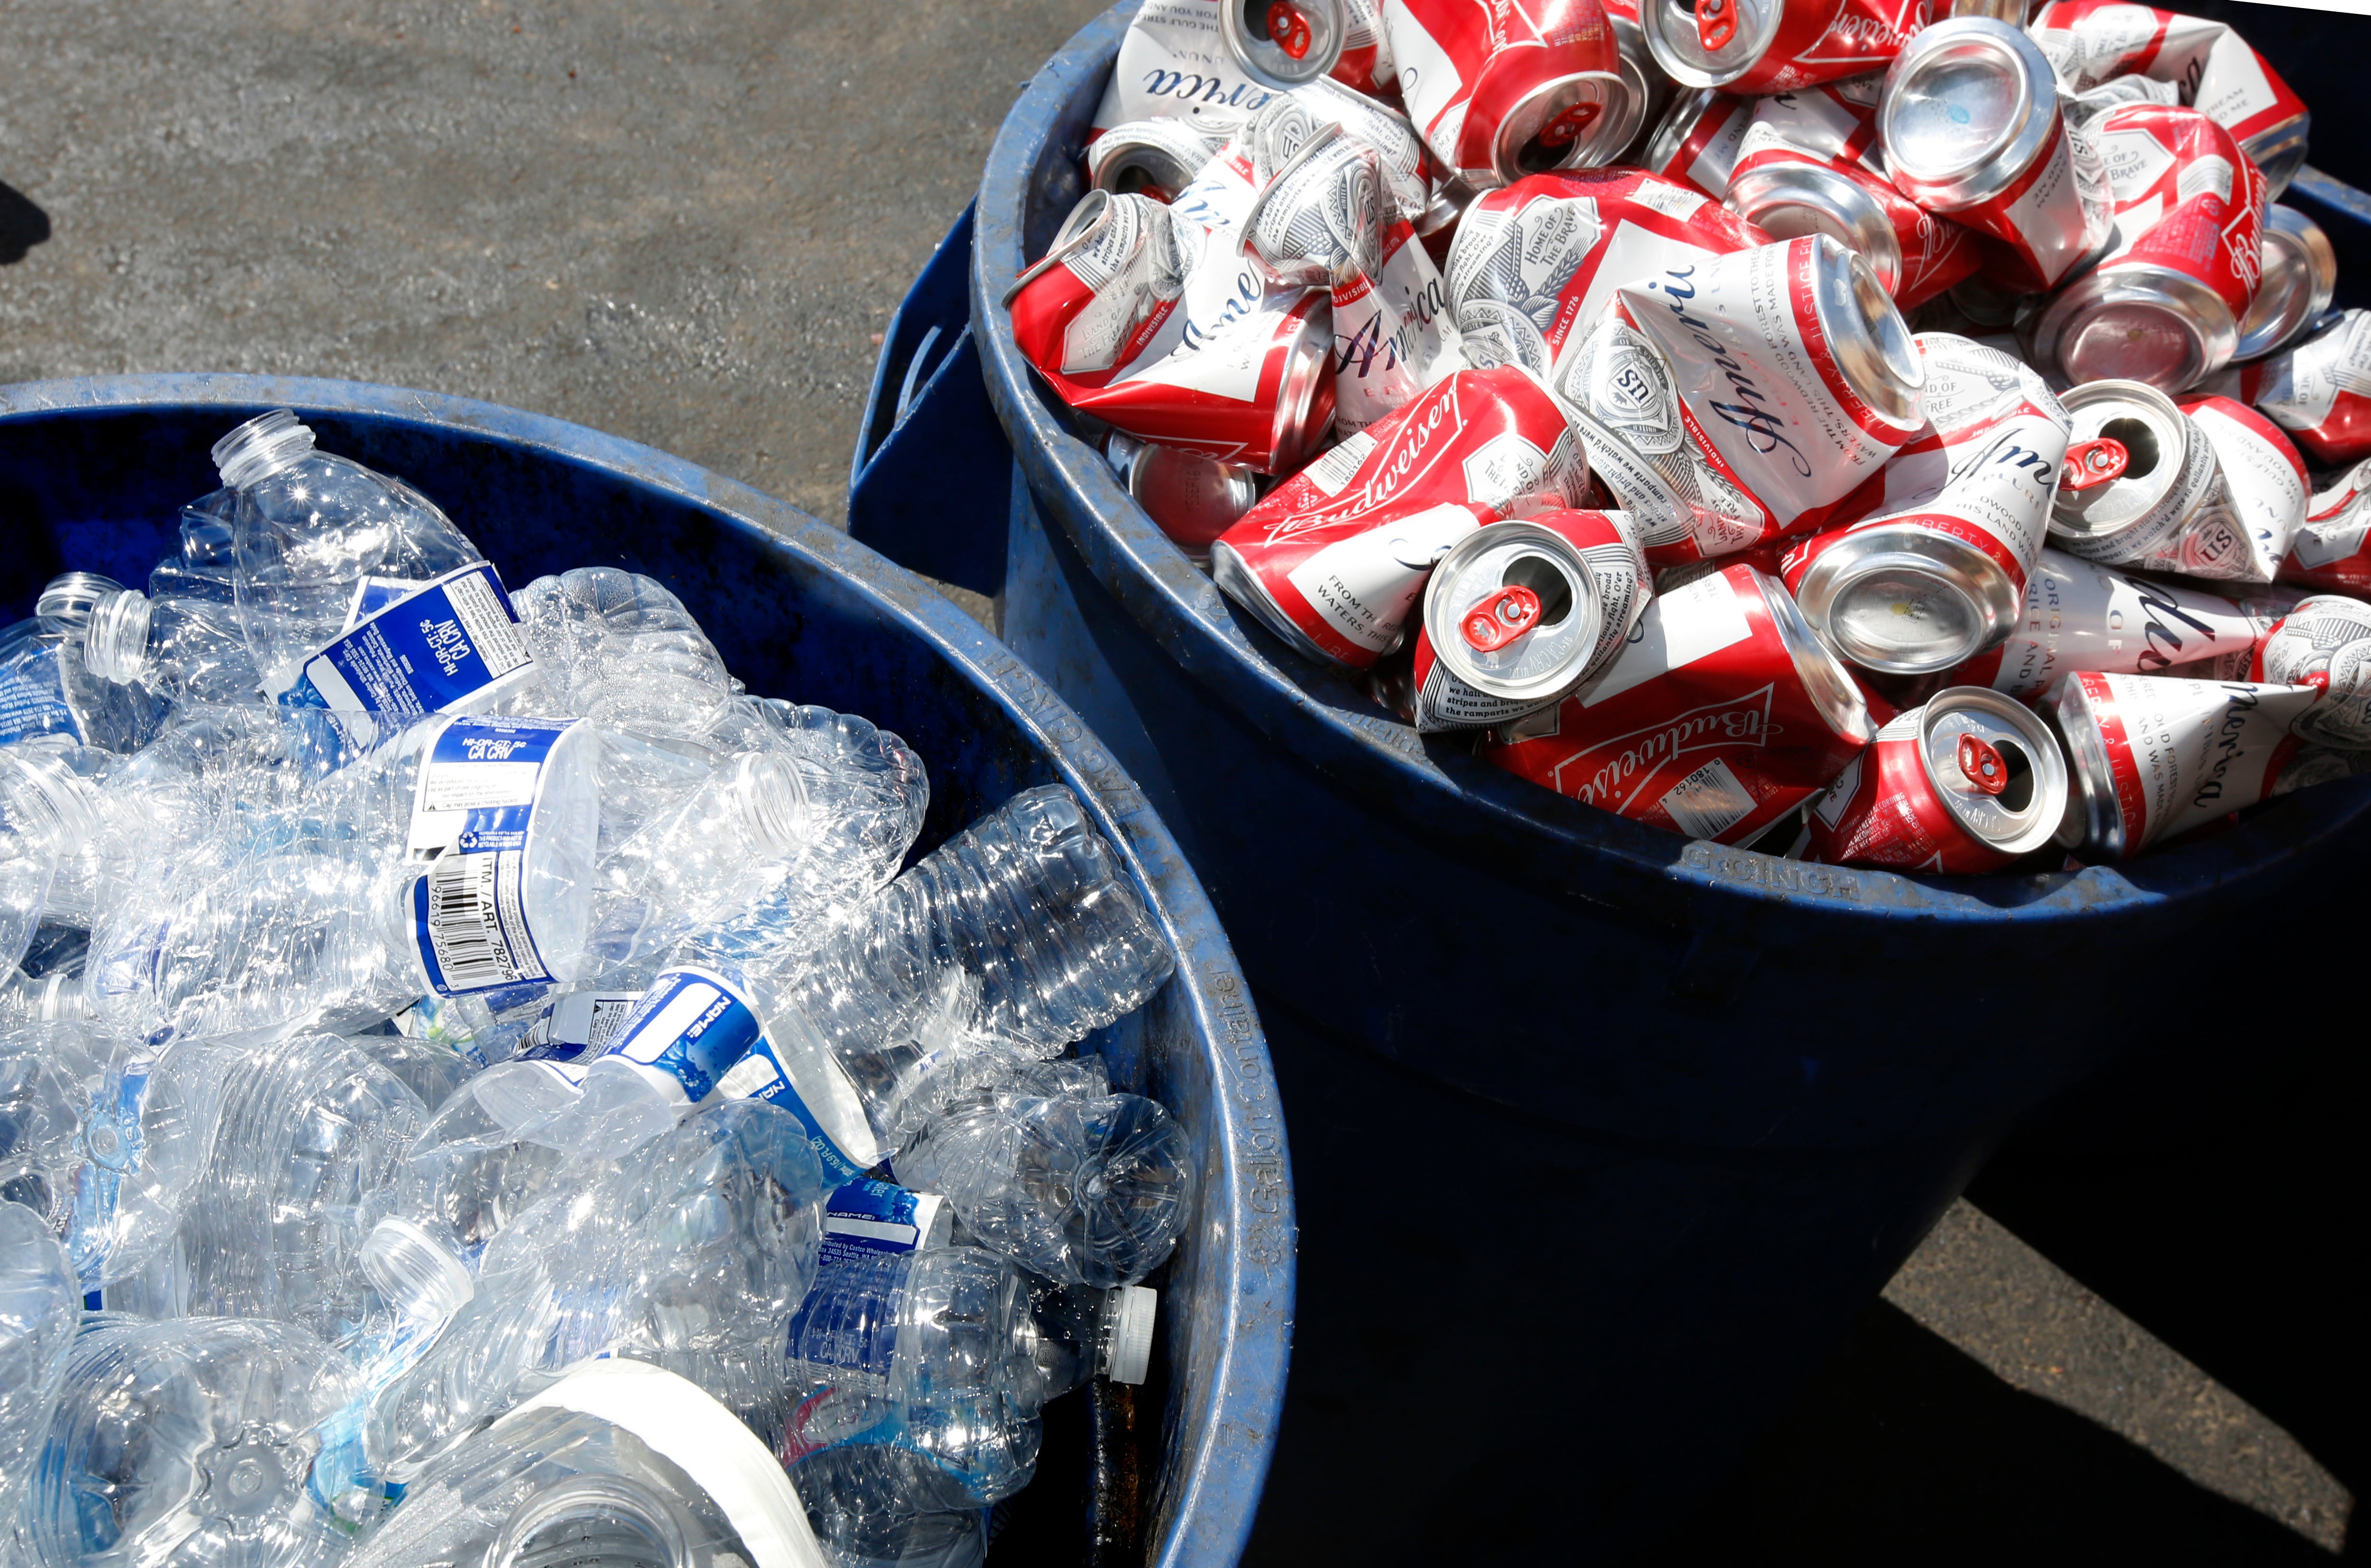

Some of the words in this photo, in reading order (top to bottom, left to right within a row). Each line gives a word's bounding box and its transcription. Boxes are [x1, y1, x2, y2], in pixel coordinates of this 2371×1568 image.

[1170, 7, 1192, 15] YOU
[1172, 19, 1196, 28] GULF
[1200, 23, 1218, 32] THE
[1383, 122, 1402, 141] broad
[2111, 158, 2149, 181] BRAVE
[2112, 152, 2128, 164] OF
[1279, 192, 1290, 207] and
[1110, 261, 1119, 272] the
[1119, 227, 1128, 259] ramparts
[1463, 232, 1480, 251] broad
[1474, 234, 1487, 250] O'er
[1524, 233, 1546, 265] HOME
[1545, 215, 1557, 230] OF
[1540, 247, 1558, 266] THE
[1559, 207, 1577, 246] BRAVE
[1092, 246, 1099, 258] we
[1102, 240, 1113, 266] stripes
[1463, 236, 1494, 279] streaming?
[1766, 267, 1778, 310] MADE
[1137, 306, 1168, 346] INDIVISIBLE
[1463, 322, 1483, 332] STATES
[1552, 317, 1569, 346] SINCE
[1565, 296, 1579, 316] 1776
[1753, 297, 1778, 351] FOREST
[1772, 315, 1789, 349] WAS
[1643, 350, 1665, 384] AMERICA
[1788, 351, 1812, 390] LAND
[1617, 369, 1649, 403] US
[1775, 353, 1817, 414] REDWOOD
[1941, 382, 1957, 392] OF
[1813, 389, 1833, 416] THIS
[1579, 426, 1596, 442] were
[1633, 425, 1657, 433] UNITED
[1684, 416, 1725, 468] INDIVISIBLE
[1818, 416, 1842, 441] THE
[1834, 419, 1877, 458] WATERS,
[1263, 386, 1457, 532] Budweiser
[1593, 439, 1626, 466] watch'd
[1624, 462, 1634, 472] we
[1835, 440, 1866, 466] FROM
[1340, 453, 1367, 486] 180162
[1614, 472, 1632, 491] bright
[1627, 486, 1645, 501] and
[1635, 474, 1667, 504] ramparts
[2131, 540, 2142, 550] we
[2143, 515, 2171, 542] watch'd
[2170, 498, 2187, 518] were
[2185, 489, 2193, 498] so
[2191, 454, 2210, 487] gallantly
[1645, 516, 1657, 527] we
[1987, 512, 2017, 541] LAND
[2116, 528, 2139, 547] bright
[2139, 513, 2156, 529] stars
[2157, 485, 2181, 513] through
[2199, 529, 2232, 562] US
[1329, 575, 1362, 609] FROM
[1318, 584, 1364, 634] WATERS,
[1367, 630, 1388, 642] THIS
[1590, 628, 1619, 668] gallantly
[1616, 572, 1634, 628] streaming?
[1608, 595, 1620, 623] fight,
[435, 619, 462, 644] CRV
[2040, 579, 2061, 675] ORIGINAL
[426, 631, 459, 676] HI-OR-CT:
[449, 639, 470, 660] CA
[2019, 640, 2039, 679] AND
[1446, 698, 1478, 707] stripes
[1480, 699, 1498, 708] and
[1449, 686, 1461, 695] we
[1445, 707, 1461, 716] the
[1463, 708, 1510, 718] ramparts
[462, 738, 512, 749] HI-OR-CT:
[467, 746, 485, 760] CA
[487, 746, 514, 760] CRV
[1577, 707, 1783, 806] Budweise
[2148, 750, 2163, 780] WAS
[1674, 767, 1710, 796] 180162
[1873, 792, 1905, 812] ACCORDING
[1854, 825, 1881, 842] ALCOHOLIC
[1859, 831, 1883, 849] BECAUSE
[480, 857, 493, 888] ITM.
[430, 886, 442, 929] 96619
[481, 901, 498, 933] ART.
[434, 933, 453, 971] 75680
[491, 940, 517, 981] 782796
[686, 996, 731, 1039] NAME:
[1247, 1112, 1283, 1216] Gallon
[827, 1212, 875, 1220] NAME:
[849, 1244, 865, 1253] Costco
[820, 1341, 832, 1360] CA
[840, 1345, 860, 1363] CRV
